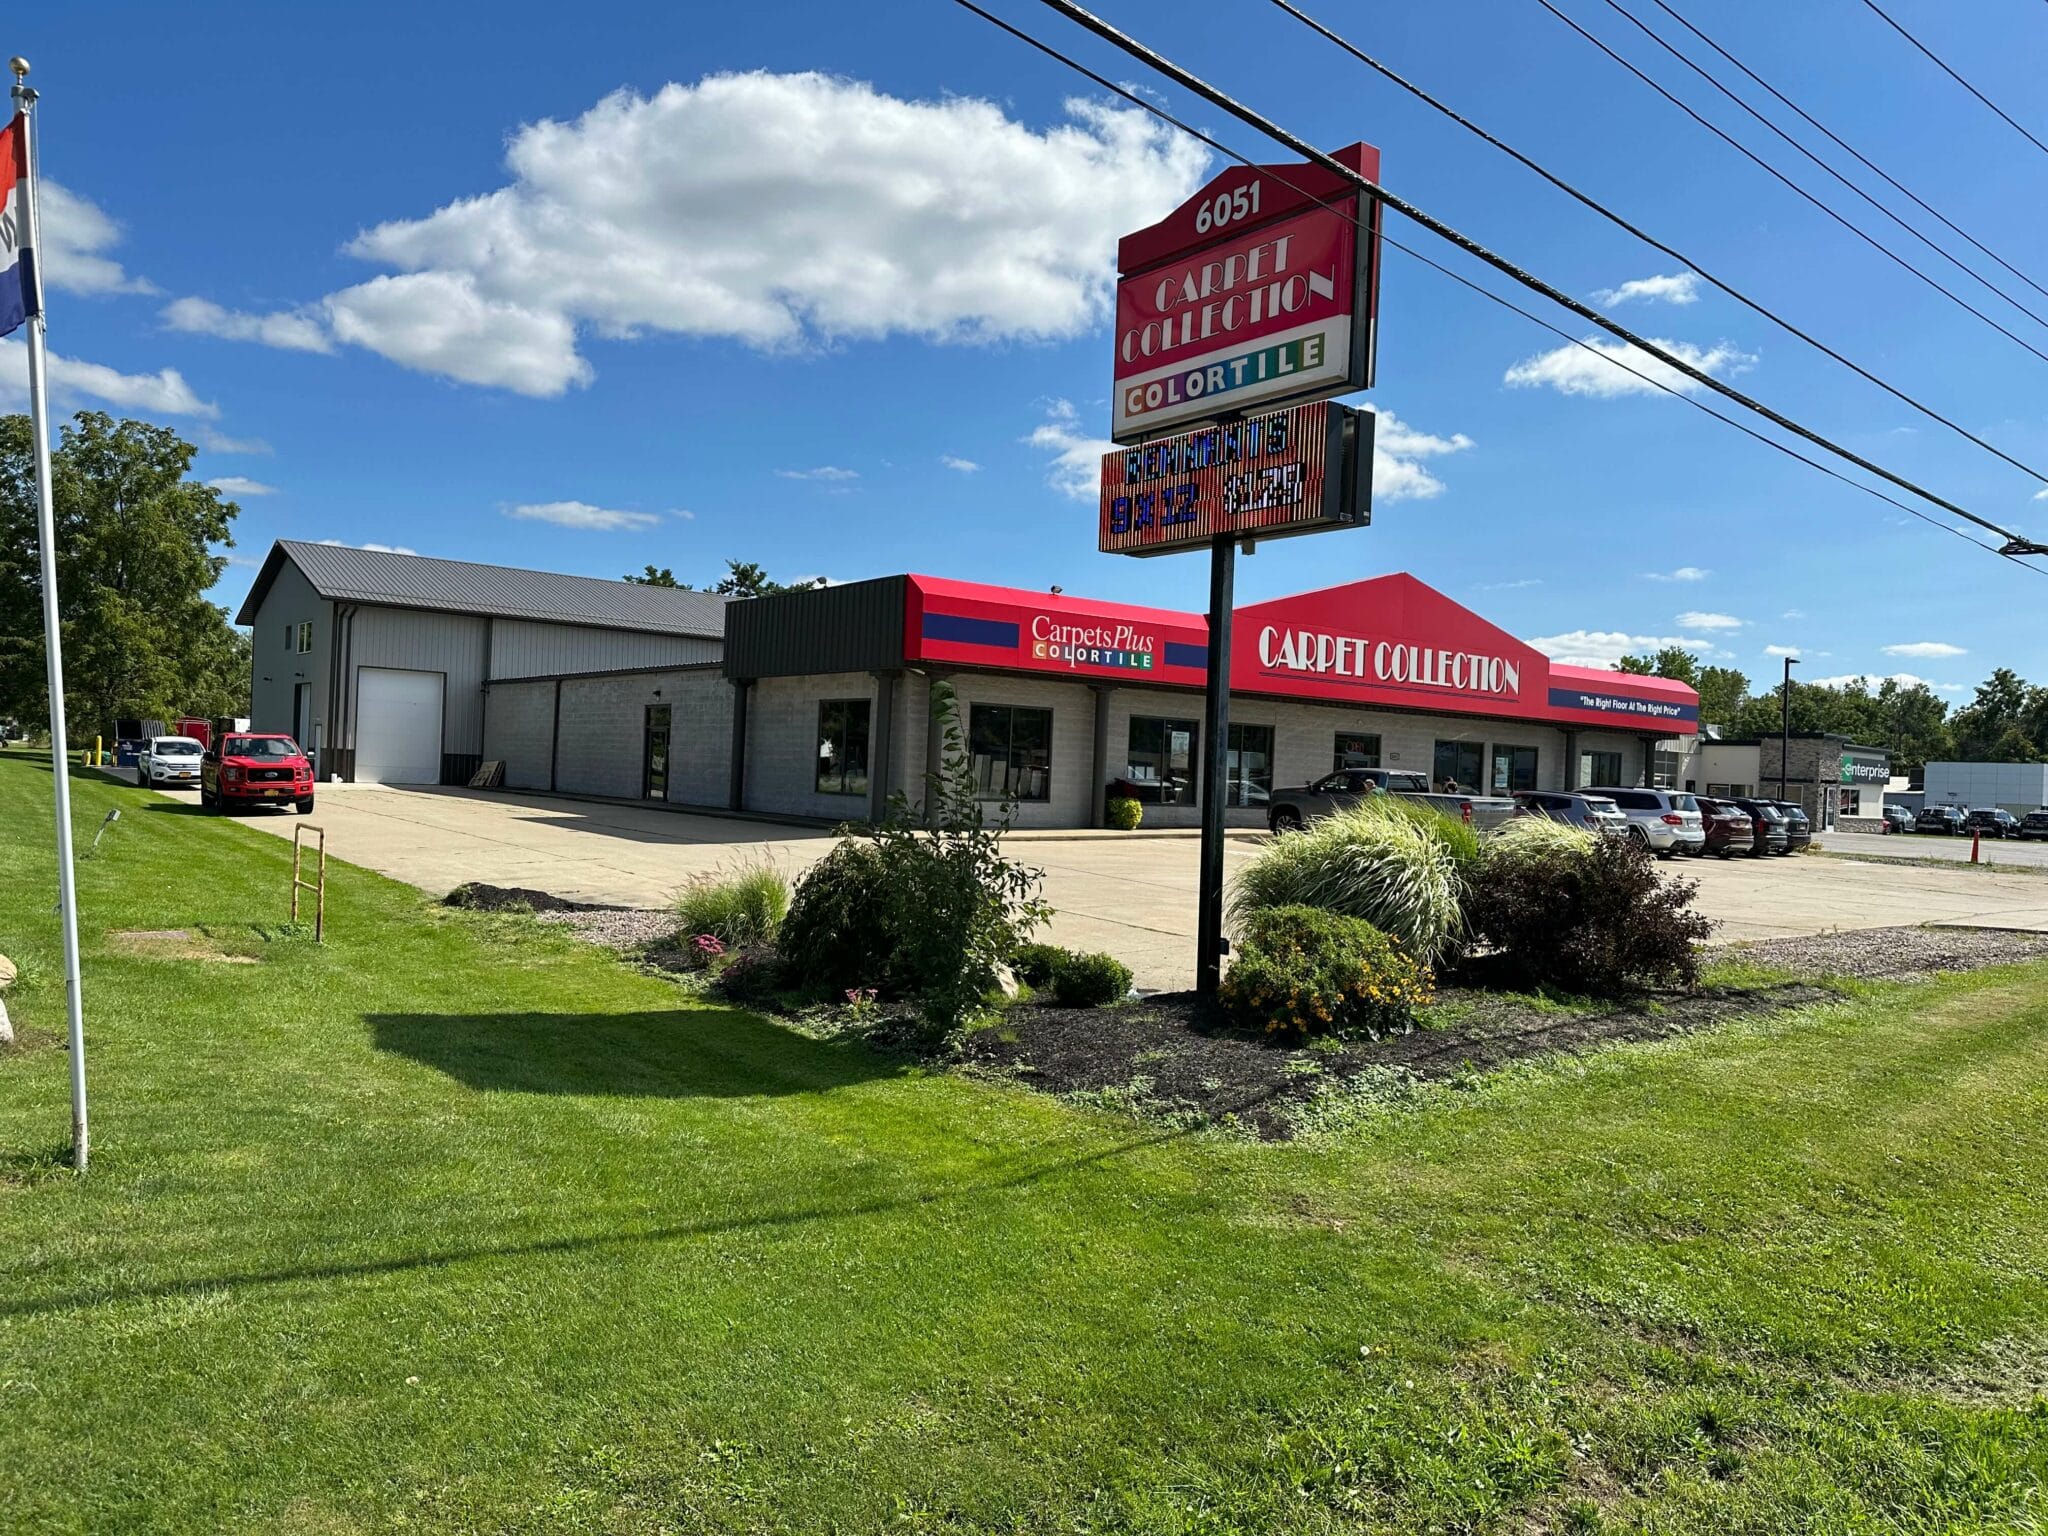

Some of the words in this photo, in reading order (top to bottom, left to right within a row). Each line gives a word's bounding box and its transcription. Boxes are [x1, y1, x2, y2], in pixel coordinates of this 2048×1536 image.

[1195, 180, 1260, 234] 6051
[1155, 234, 1295, 312] CARPET
[1122, 264, 1335, 363] COLLECTION
[1127, 337, 1320, 413] COLORTILE
[1035, 643, 1152, 668] COLORTILE
[1259, 625, 1369, 677] CARPET
[1374, 641, 1520, 695] COLLECTION
[1596, 698, 1611, 710] Right
[1612, 699, 1627, 710] Floor
[1636, 702, 1646, 712] The
[1647, 703, 1662, 715] Right
[1844, 763, 1890, 780] enterprise
